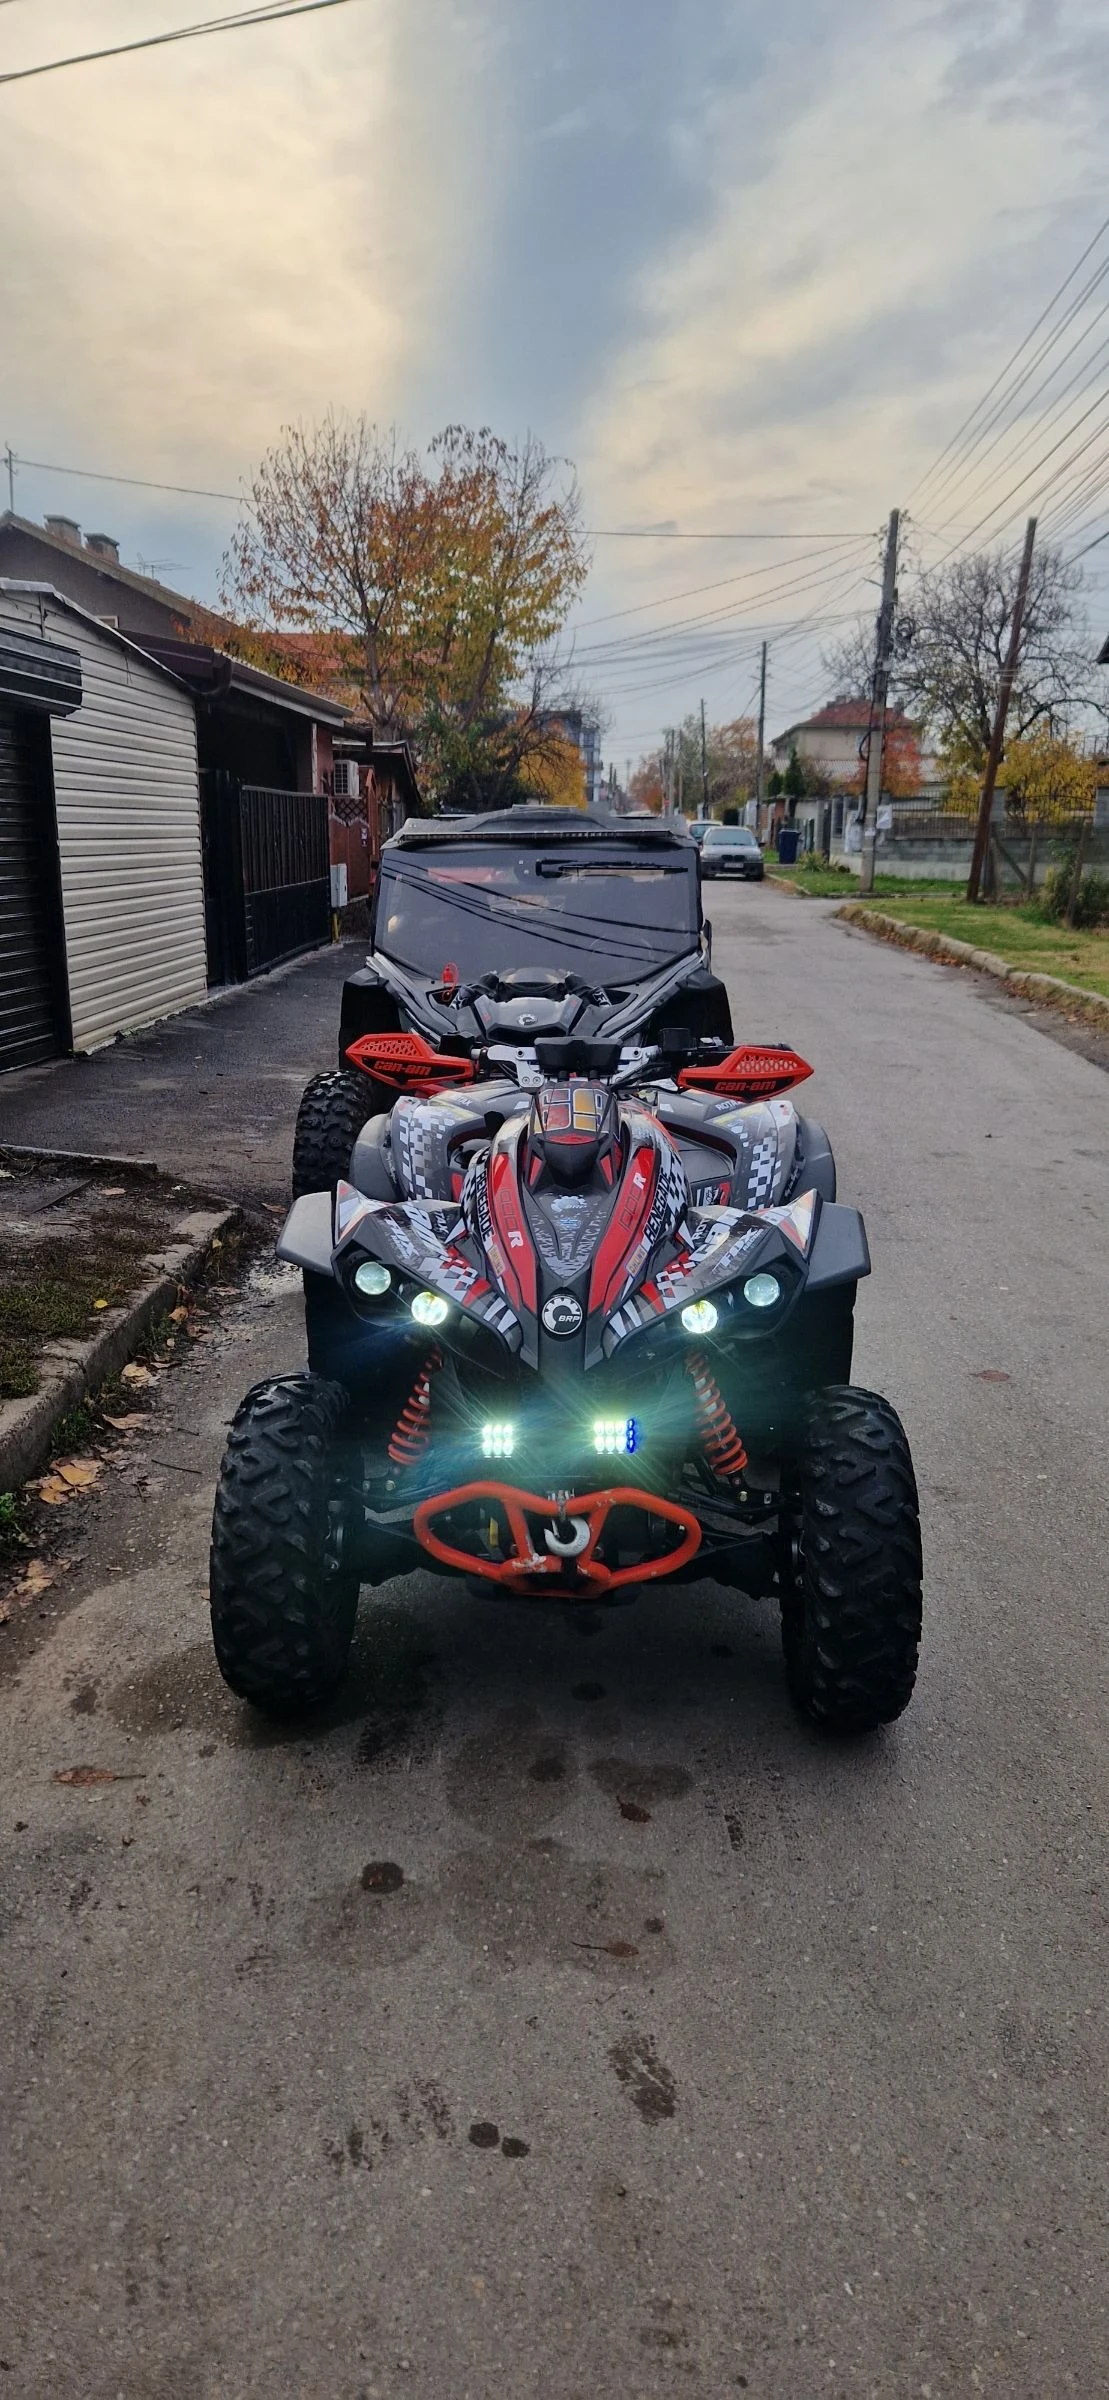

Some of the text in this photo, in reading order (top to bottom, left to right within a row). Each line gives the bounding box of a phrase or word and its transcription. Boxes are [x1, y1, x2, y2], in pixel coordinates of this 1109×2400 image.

[373, 1060, 431, 1076] can-am
[714, 1080, 777, 1091] can-am
[476, 1167, 495, 1242] RENEGADE
[643, 1168, 671, 1245] RENEGADE
[558, 1314, 580, 1323] BRP
